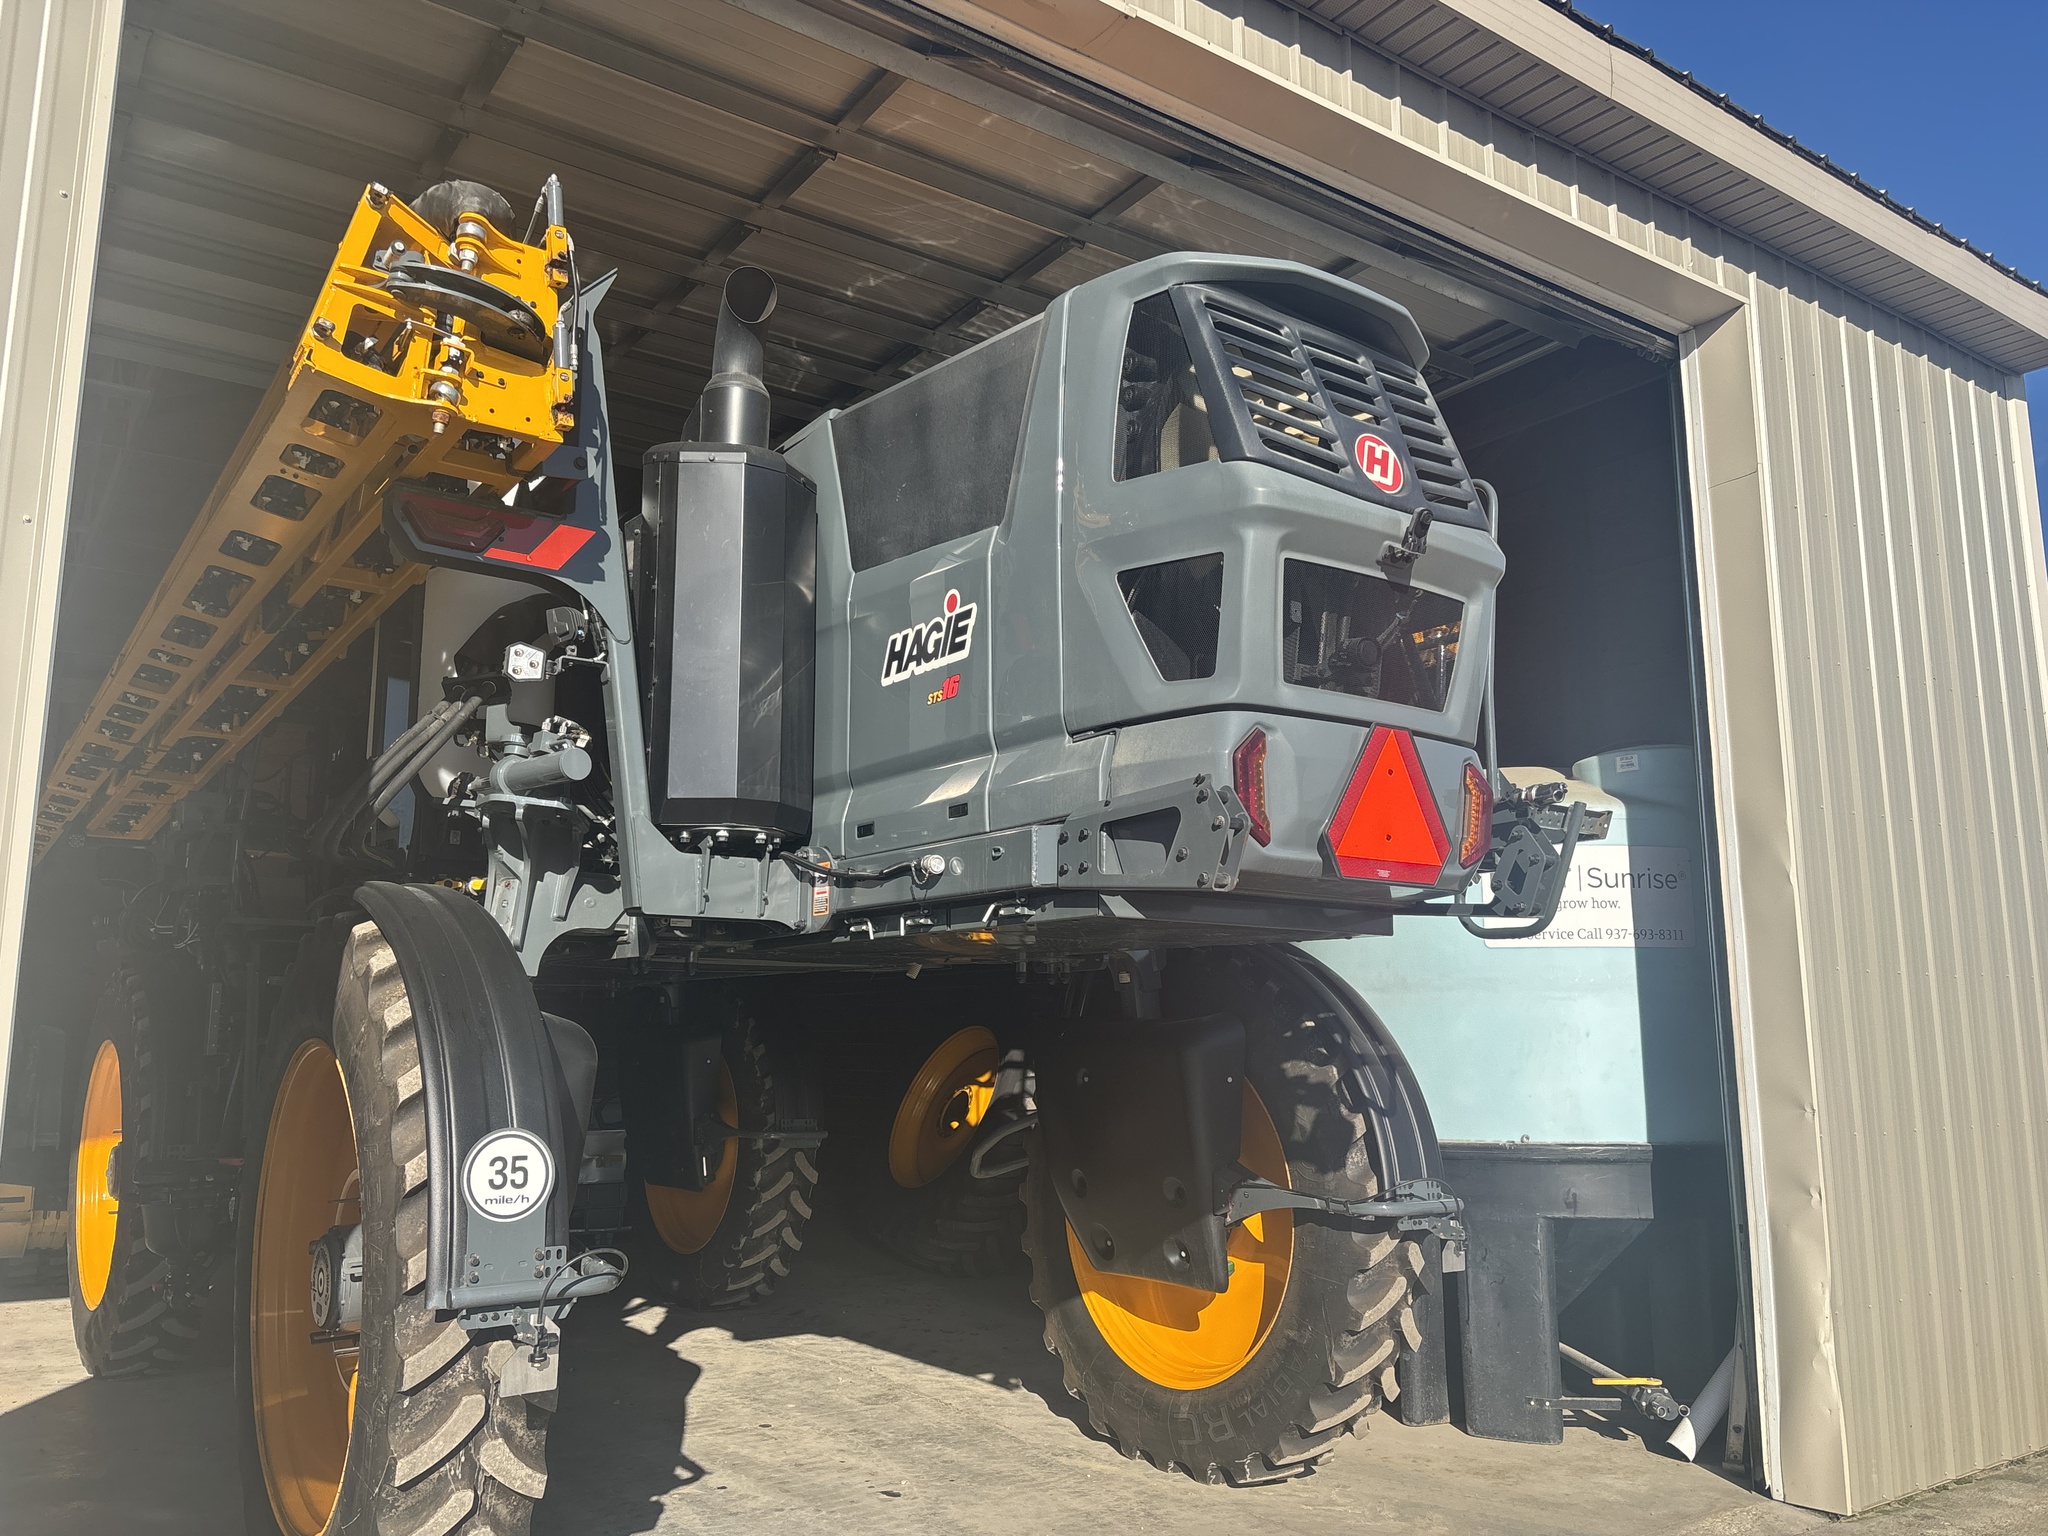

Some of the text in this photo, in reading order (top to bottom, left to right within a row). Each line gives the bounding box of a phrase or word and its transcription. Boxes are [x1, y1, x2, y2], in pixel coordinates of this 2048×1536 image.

[1363, 440, 1395, 486] H
[882, 592, 976, 684] HAGIE
[1591, 897, 1621, 909] how.
[1577, 927, 1603, 940] Call
[1605, 928, 1685, 941] 937-693-8311
[488, 1155, 529, 1190] 35
[484, 1194, 530, 1205] mile/h
